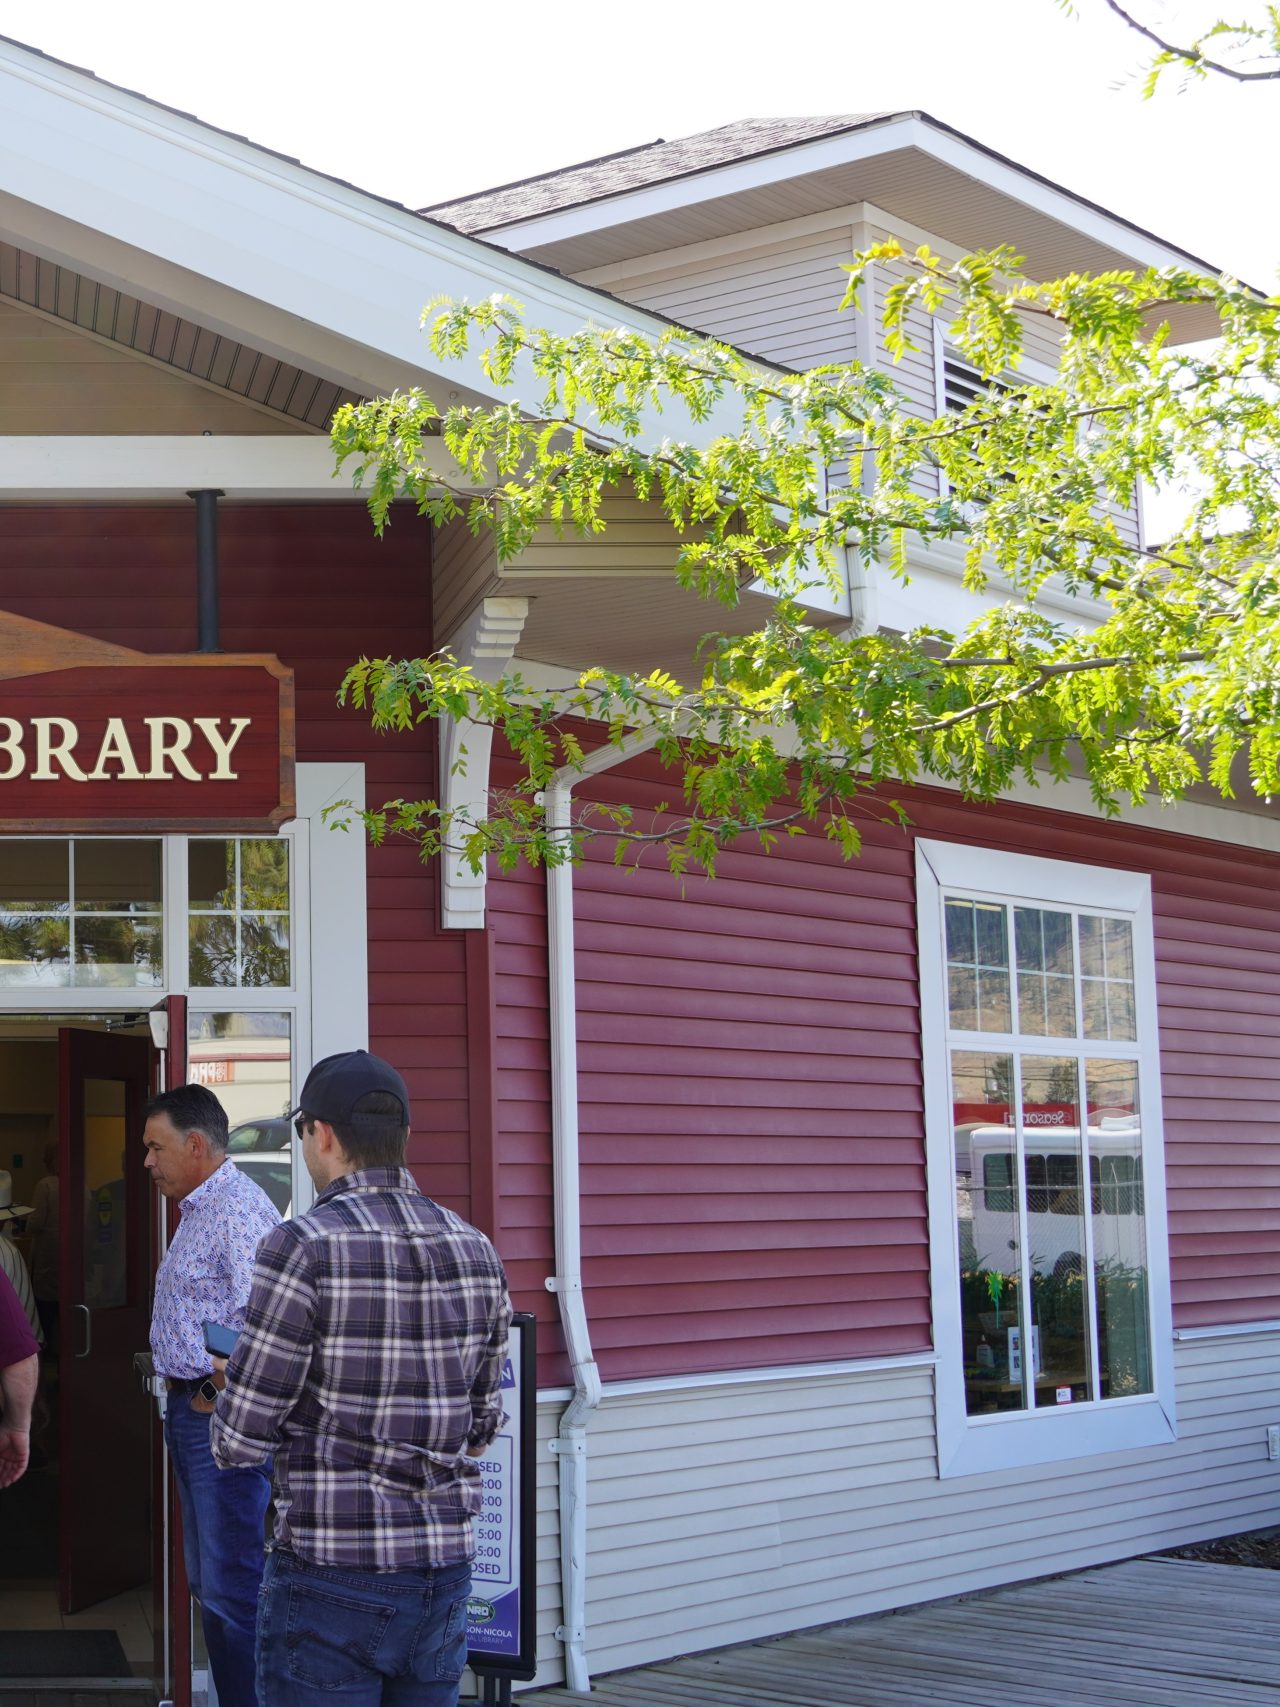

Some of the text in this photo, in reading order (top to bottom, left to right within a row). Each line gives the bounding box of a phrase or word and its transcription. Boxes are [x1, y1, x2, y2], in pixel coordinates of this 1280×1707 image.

[480, 1462, 502, 1473] SED
[478, 1513, 502, 1524] 5:00
[478, 1529, 502, 1541] 5:00
[477, 1546, 501, 1558] 5:00
[471, 1562, 501, 1575] OSED
[466, 1604, 489, 1616] NRD
